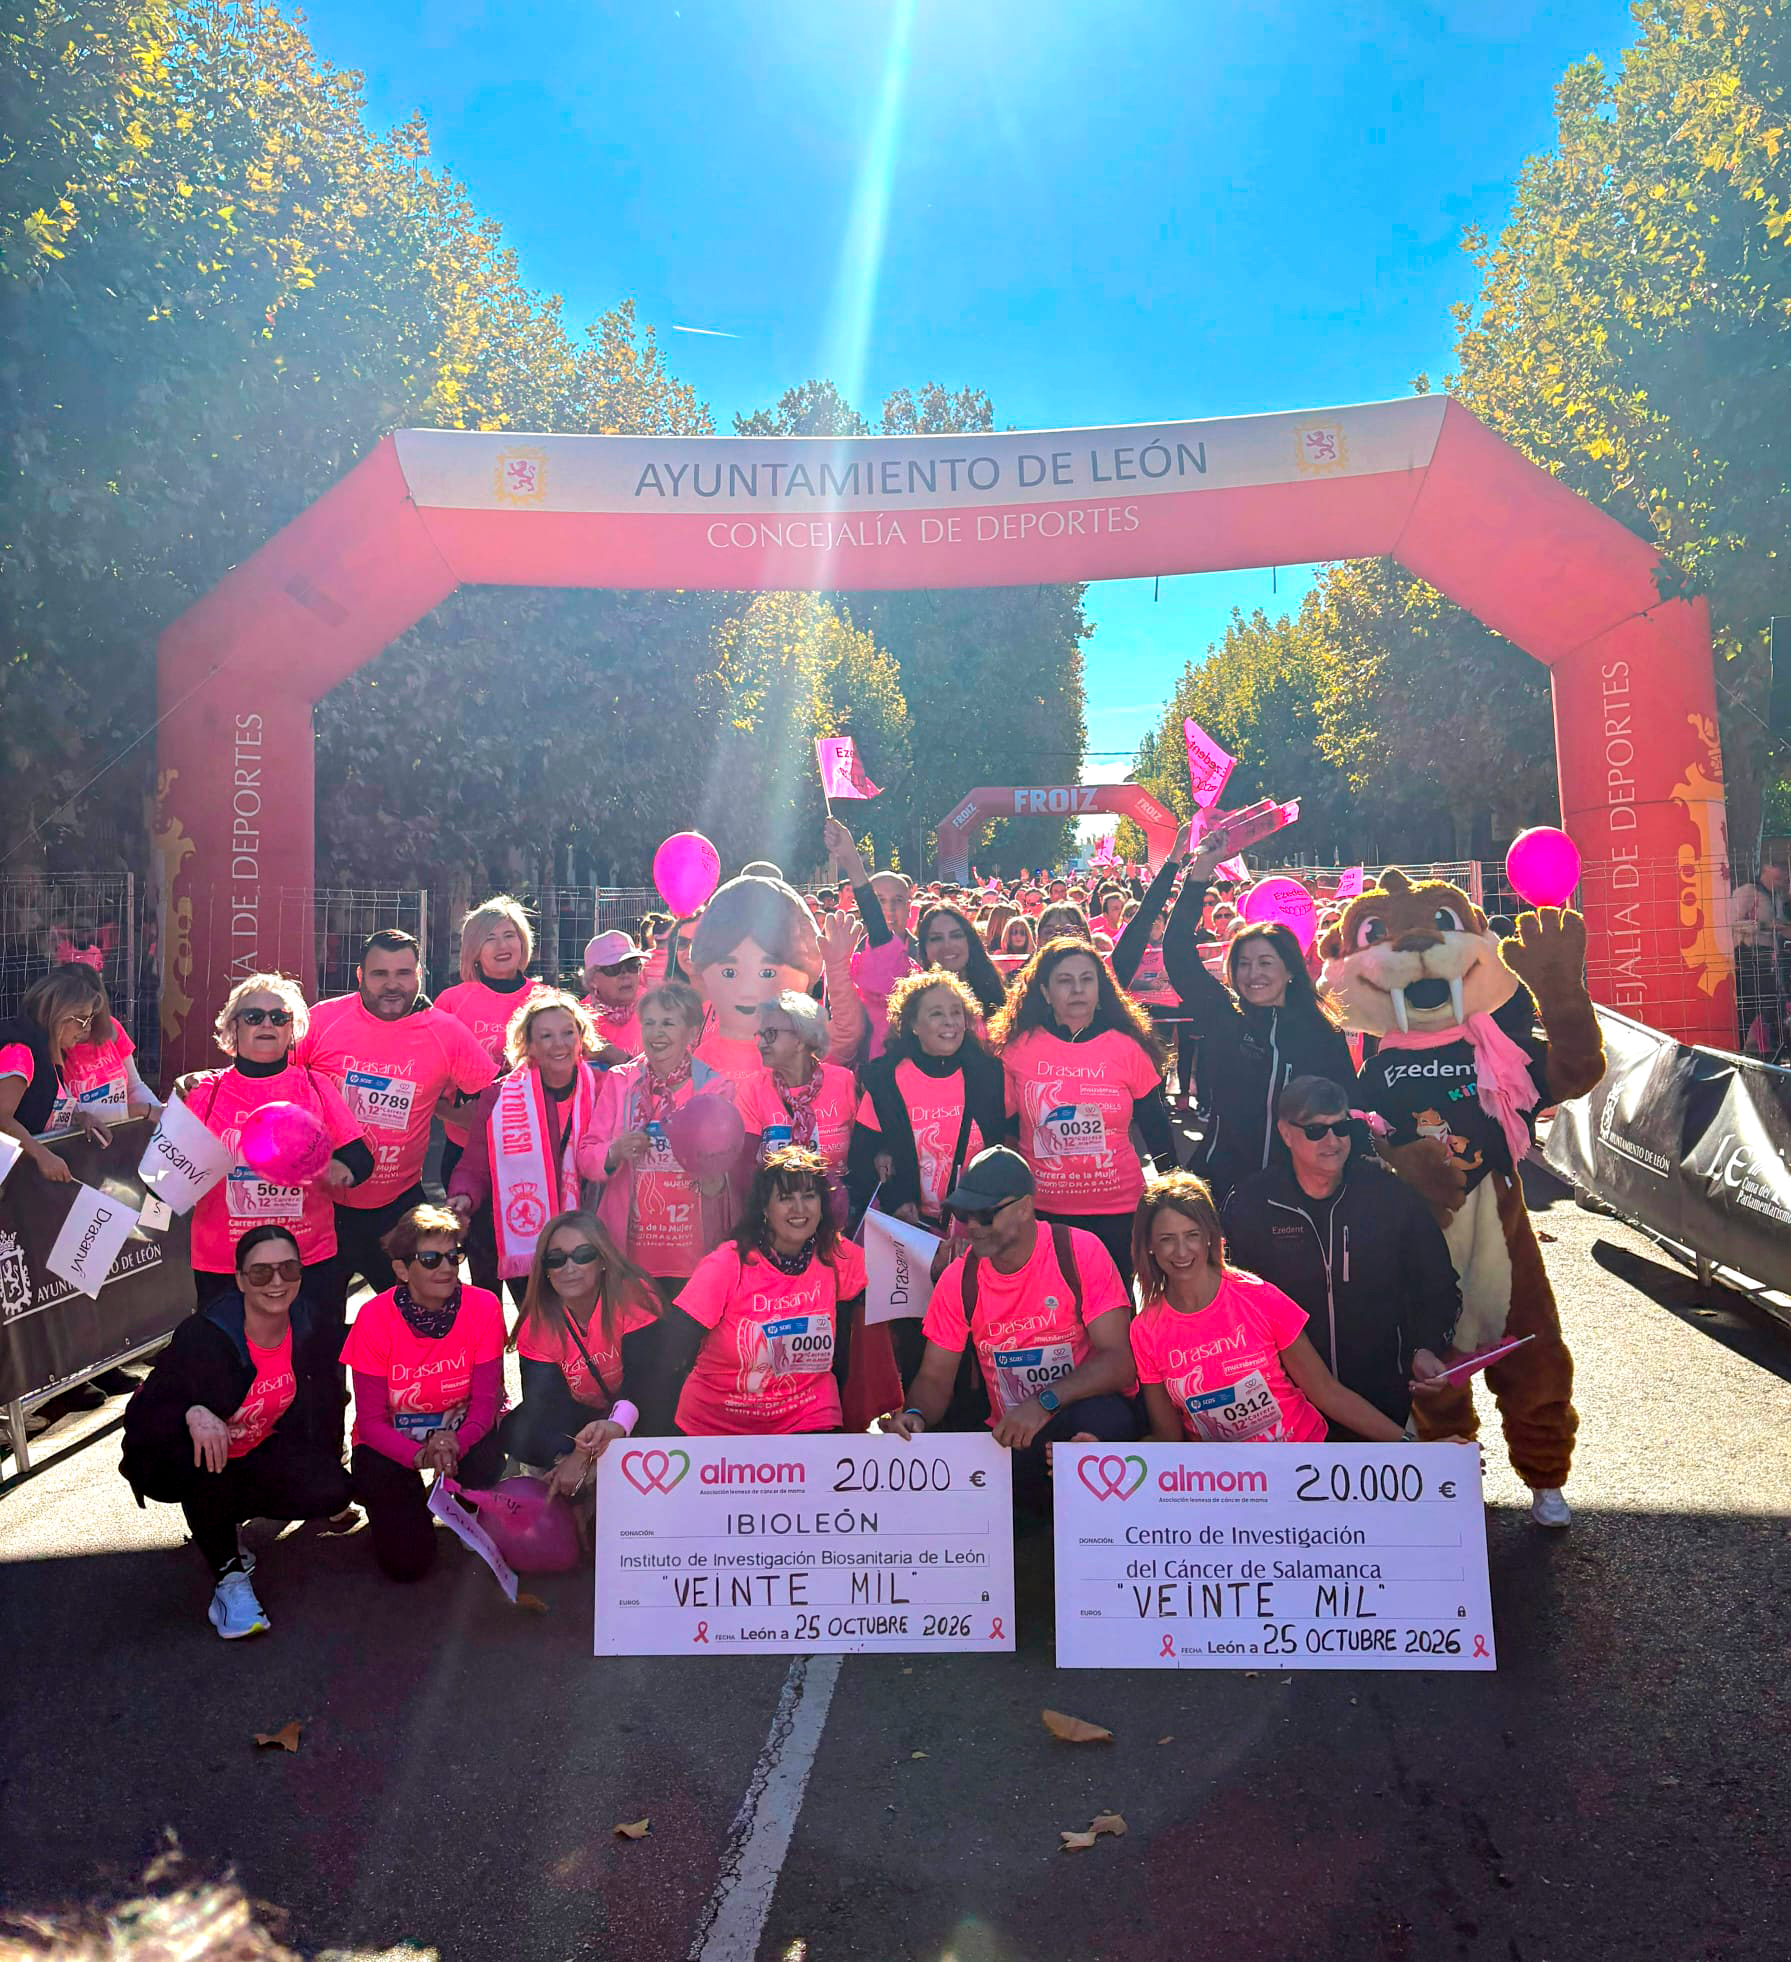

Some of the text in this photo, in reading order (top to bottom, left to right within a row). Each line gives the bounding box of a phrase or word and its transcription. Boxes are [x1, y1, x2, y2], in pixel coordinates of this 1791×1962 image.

[635, 438, 1208, 498] AYUNTAMIENTO DE LEÓN
[706, 505, 1140, 551] CONCEJALÍA DE DEPORTES
[231, 713, 263, 880] DEPORTES
[1014, 788, 1098, 813] FROIZ
[1137, 797, 1164, 823] FROIZ
[951, 802, 978, 829] FROIZ
[1602, 660, 1647, 1023] EJALÍA DE DEPORTES
[231, 895, 259, 936] DE
[474, 1019, 506, 1034] Dras
[342, 1055, 415, 1076] Drasanvi
[1037, 1060, 1108, 1079] Drasanvi
[368, 1092, 410, 1110] 0789
[772, 1098, 839, 1125] Drnvi
[1060, 1120, 1103, 1136] 0032
[1068, 1171, 1081, 1180] de
[1094, 1168, 1118, 1179] Mujer
[70, 1207, 113, 1279] Drasanvi
[1271, 1225, 1304, 1235] Ezedent
[121, 1253, 134, 1270] DE
[136, 1243, 162, 1264] LEÓN
[890, 1235, 910, 1305] Drasanvi
[753, 1280, 822, 1312] Drasanvi
[987, 1308, 1057, 1337] Drasanvi
[791, 1334, 832, 1351] 0000
[1168, 1323, 1248, 1369] Drasanvi
[391, 1346, 466, 1381] Drasanvi
[1026, 1363, 1073, 1383] 0020
[1223, 1391, 1273, 1421] 0312
[700, 1457, 805, 1485] almom
[833, 1457, 987, 1492] 20.000 €
[1158, 1463, 1268, 1493] almom
[1295, 1464, 1457, 1502] 20.000 €
[727, 1508, 878, 1535] IBIOLEÓN
[1125, 1526, 1192, 1545] Centro
[1199, 1525, 1224, 1545] de
[1232, 1525, 1366, 1549] Investigación
[619, 1549, 986, 1570] Instituto de Investigación Biosanitaria de León
[1126, 1558, 1382, 1579] del Cáncer de Salamanca
[741, 1627, 777, 1640] León
[780, 1630, 789, 1640] a
[794, 1614, 821, 1640] 25
[827, 1614, 909, 1637] OCTUBRE
[922, 1614, 973, 1637] 2026
[1207, 1641, 1245, 1654] León
[1249, 1644, 1259, 1654] a
[1263, 1624, 1298, 1654] 25
[1305, 1629, 1398, 1653] OCTUBRE
[1404, 1628, 1462, 1654] 2026
